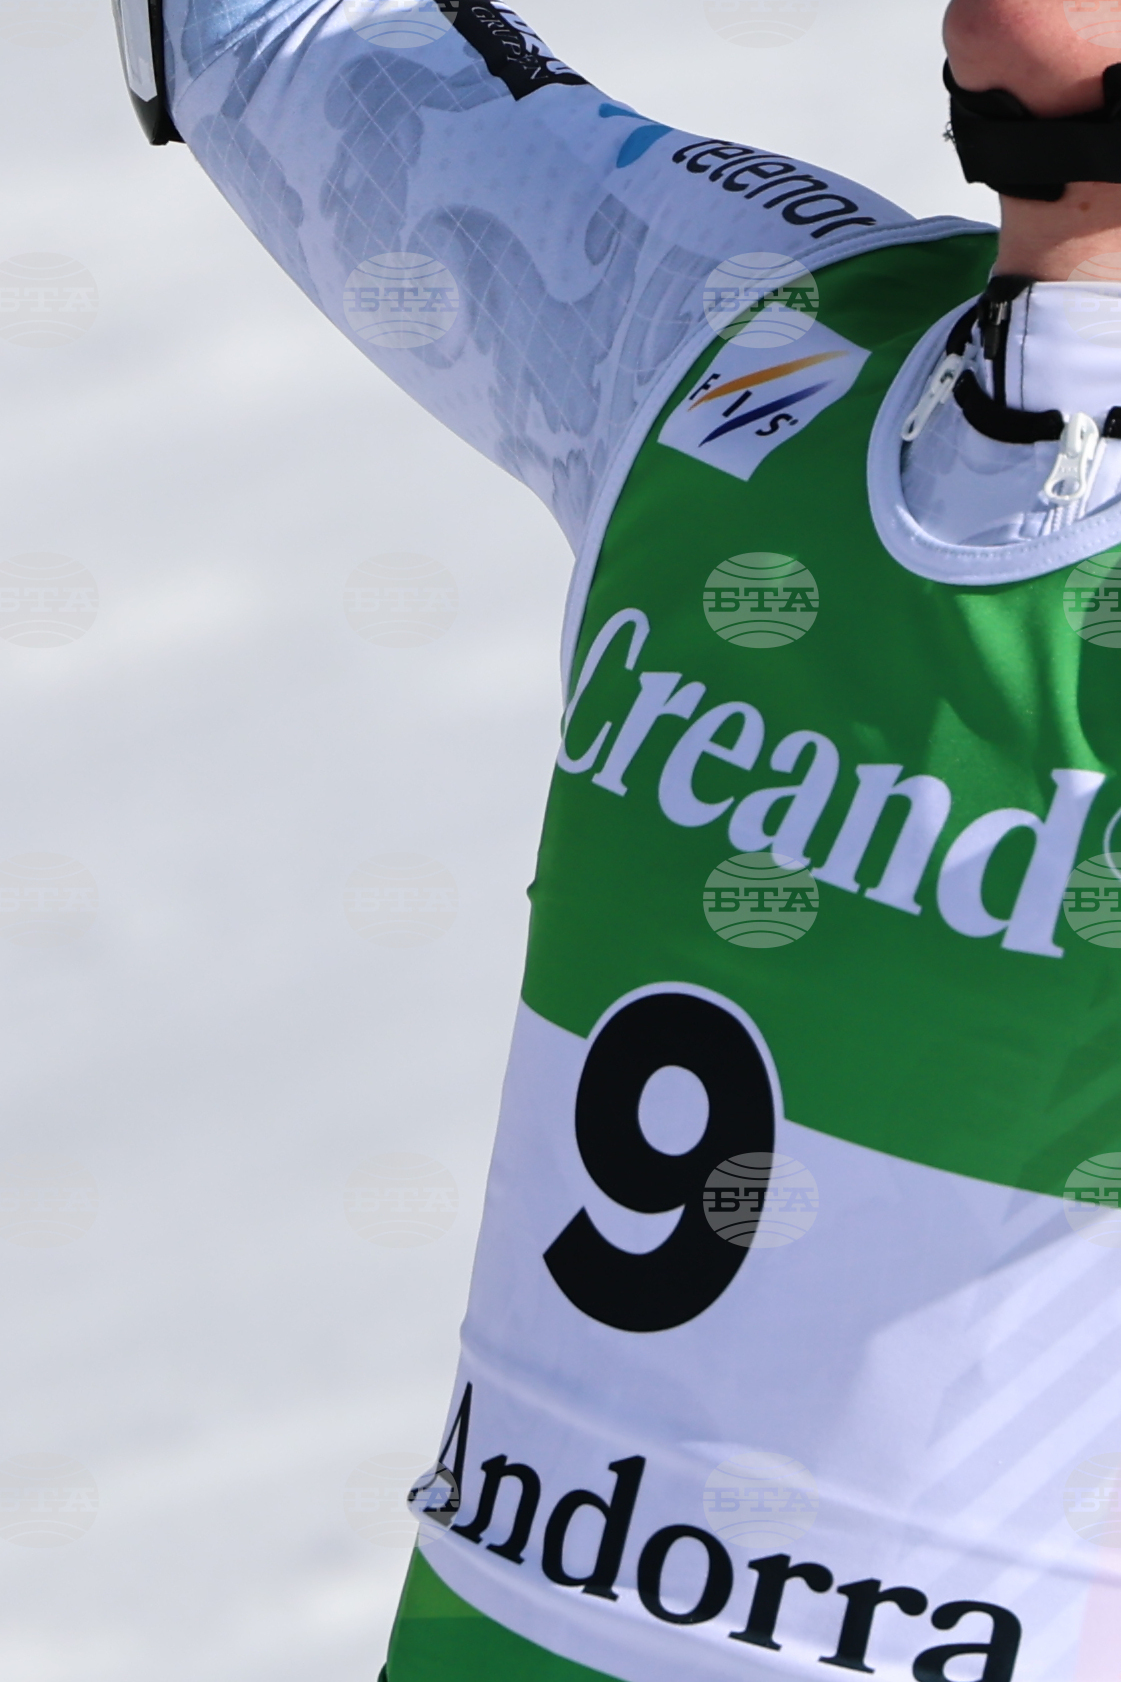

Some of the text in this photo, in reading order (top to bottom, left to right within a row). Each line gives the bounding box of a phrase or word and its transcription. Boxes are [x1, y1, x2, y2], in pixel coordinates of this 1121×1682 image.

[672, 138, 877, 239] telenor
[688, 372, 799, 437] FIS
[556, 607, 1106, 958] Creand
[542, 991, 776, 1333] 9
[407, 1381, 1023, 1682] Andorra
